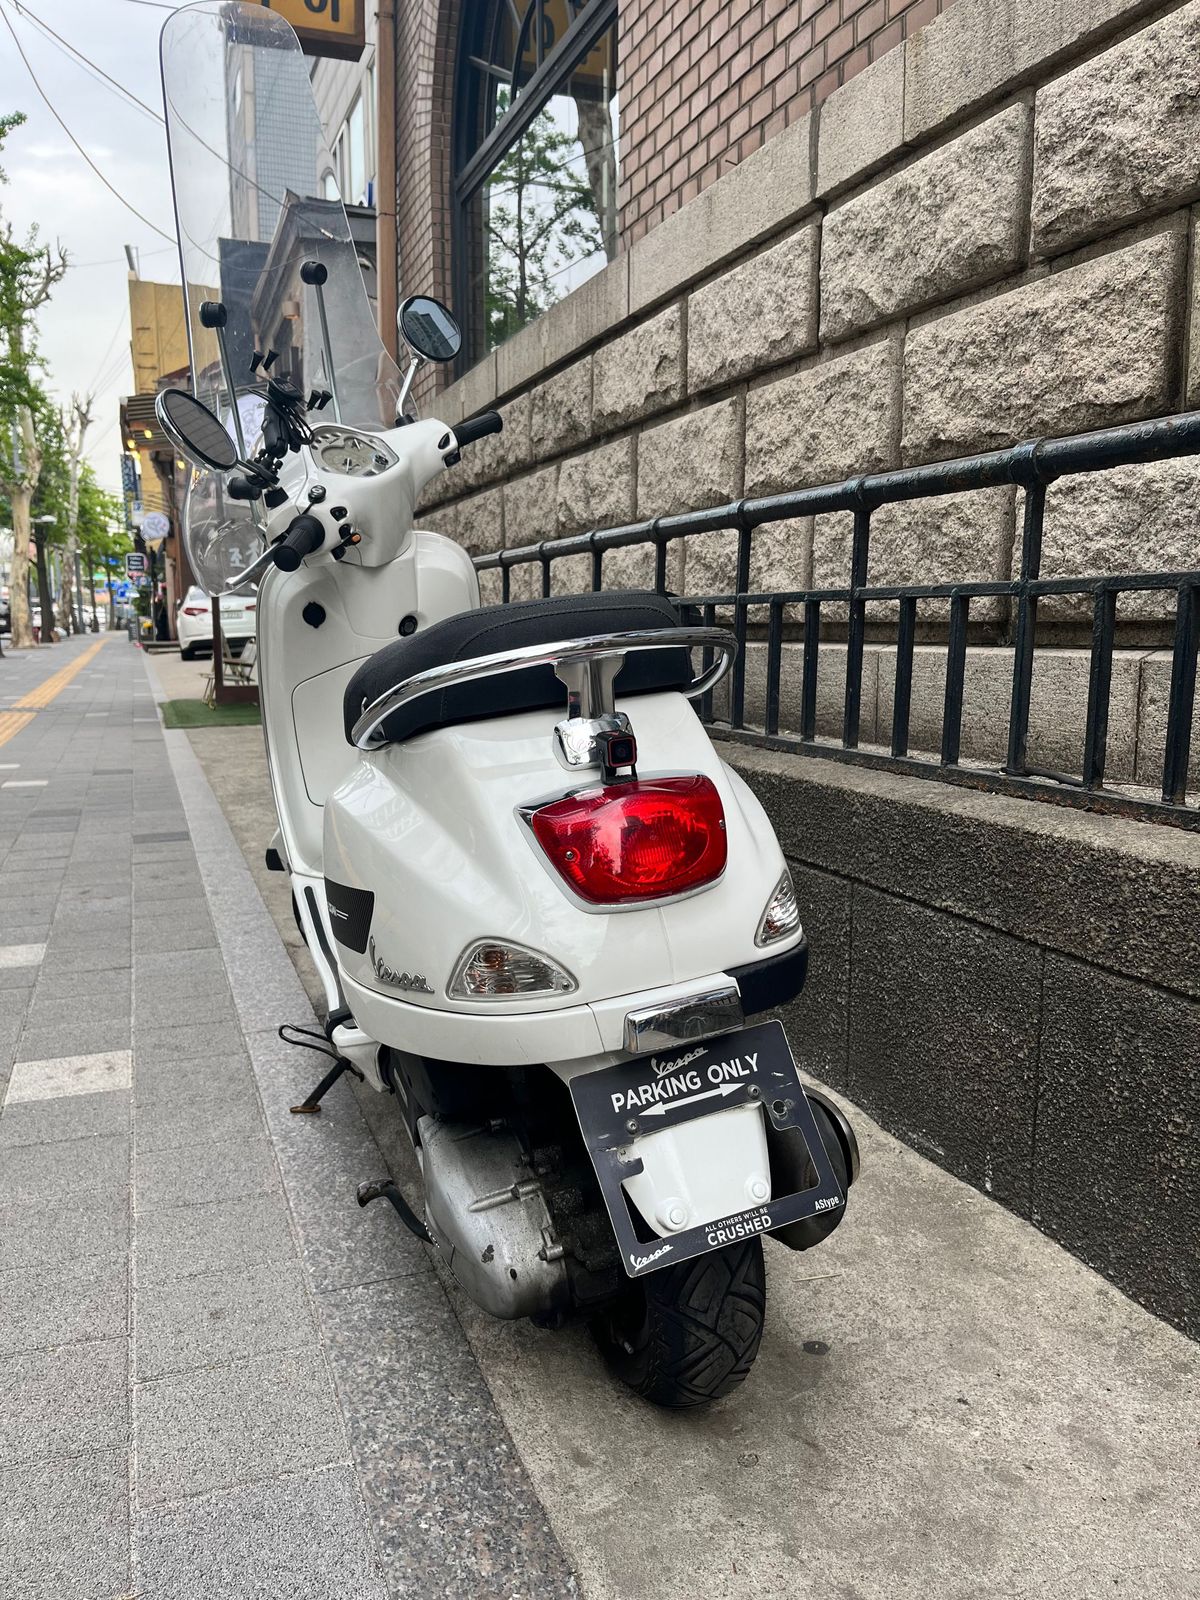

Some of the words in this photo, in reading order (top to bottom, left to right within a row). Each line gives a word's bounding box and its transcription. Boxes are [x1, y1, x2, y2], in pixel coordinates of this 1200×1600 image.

[369, 935, 435, 994] Vespa
[650, 1047, 709, 1079] Vespa
[611, 1070, 702, 1113] PARKING
[707, 1052, 759, 1084] ONLY
[815, 1196, 840, 1210] AStype
[704, 1224, 717, 1233] ALL
[718, 1215, 743, 1229] OTHERS
[743, 1210, 760, 1220] WILL
[707, 1215, 773, 1246] CRUSHED
[630, 1244, 674, 1271] Vespa
